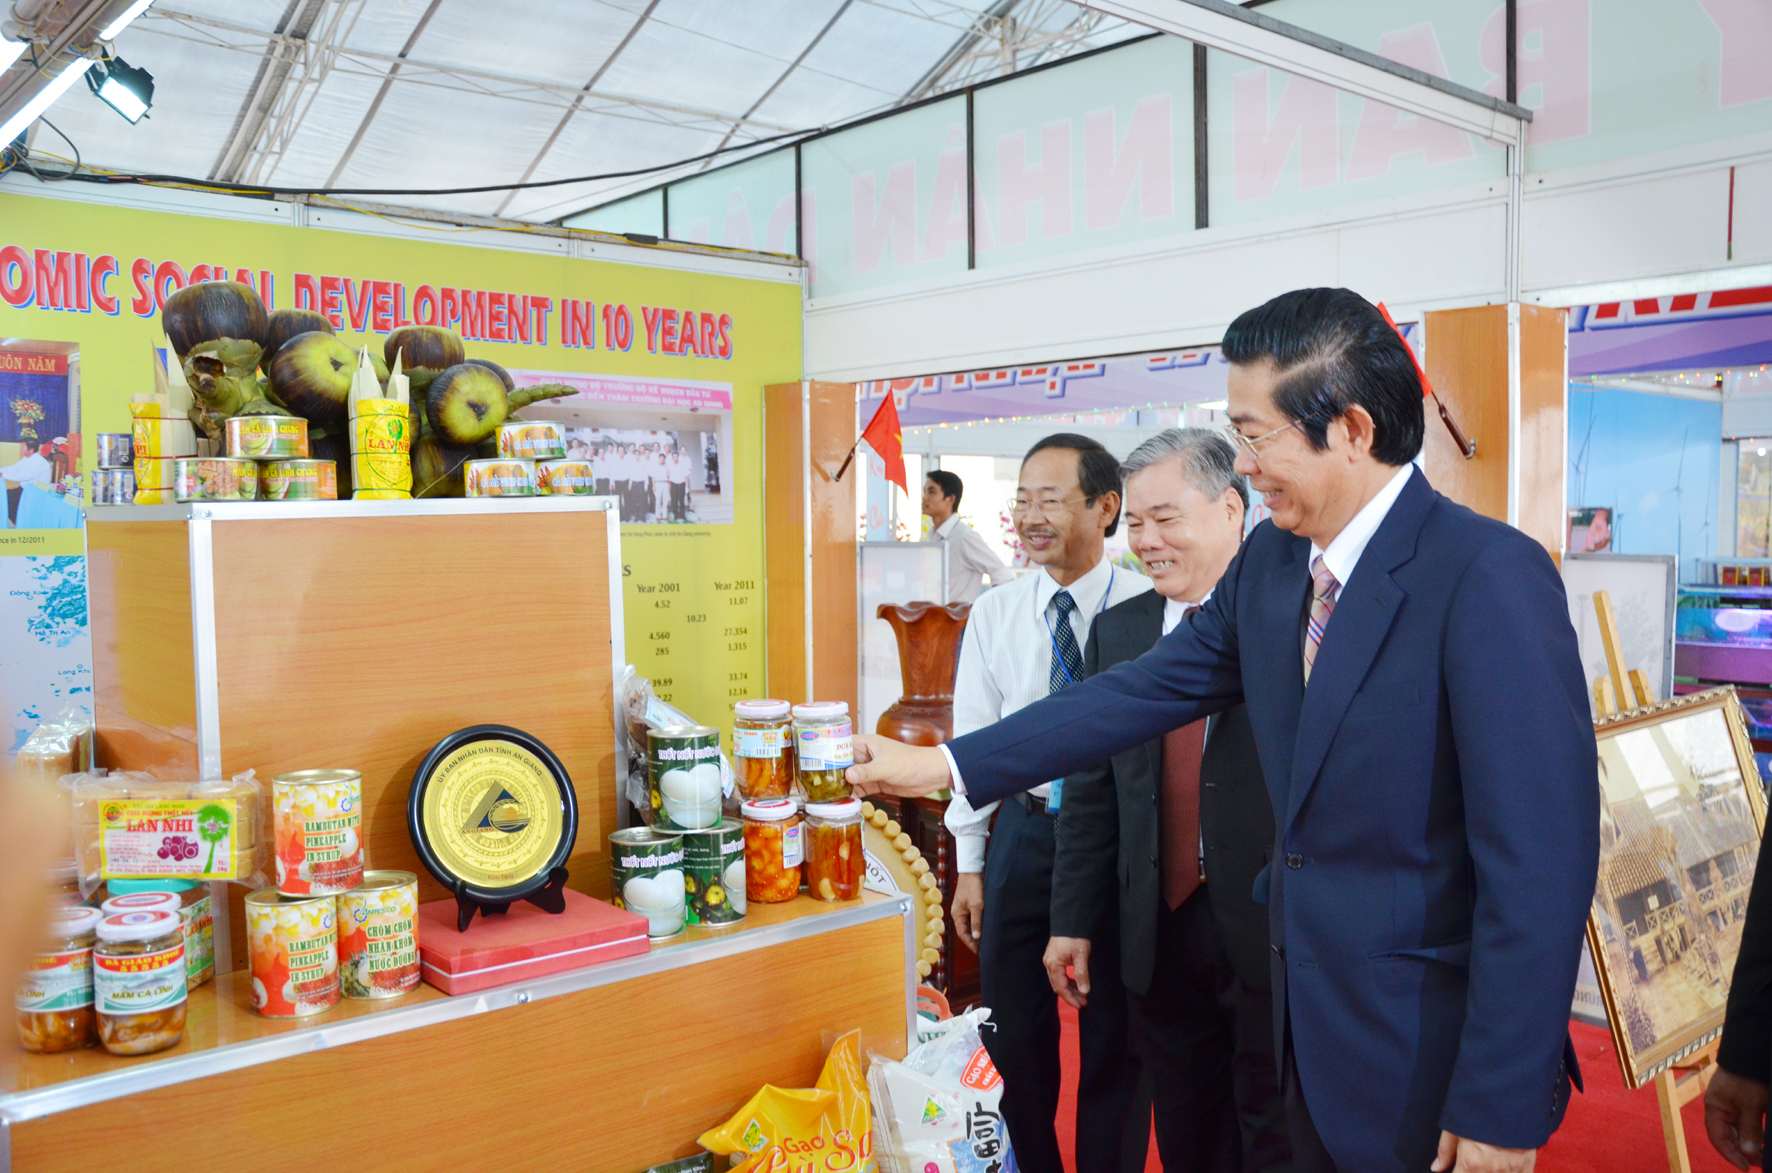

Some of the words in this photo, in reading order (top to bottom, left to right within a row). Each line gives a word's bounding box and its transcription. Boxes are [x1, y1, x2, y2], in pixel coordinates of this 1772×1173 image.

[0, 245, 119, 315] OMIC
[131, 257, 274, 318] SOL
[293, 272, 552, 345] DEVELOPMENT
[560, 298, 595, 348] IN
[602, 303, 633, 351] 10
[641, 305, 733, 361] YEARS
[637, 583, 656, 593] Year
[658, 583, 680, 593] 2001
[714, 581, 732, 591] Year
[734, 580, 754, 590] 2011
[127, 819, 158, 833] LAN
[161, 819, 193, 833] NHI
